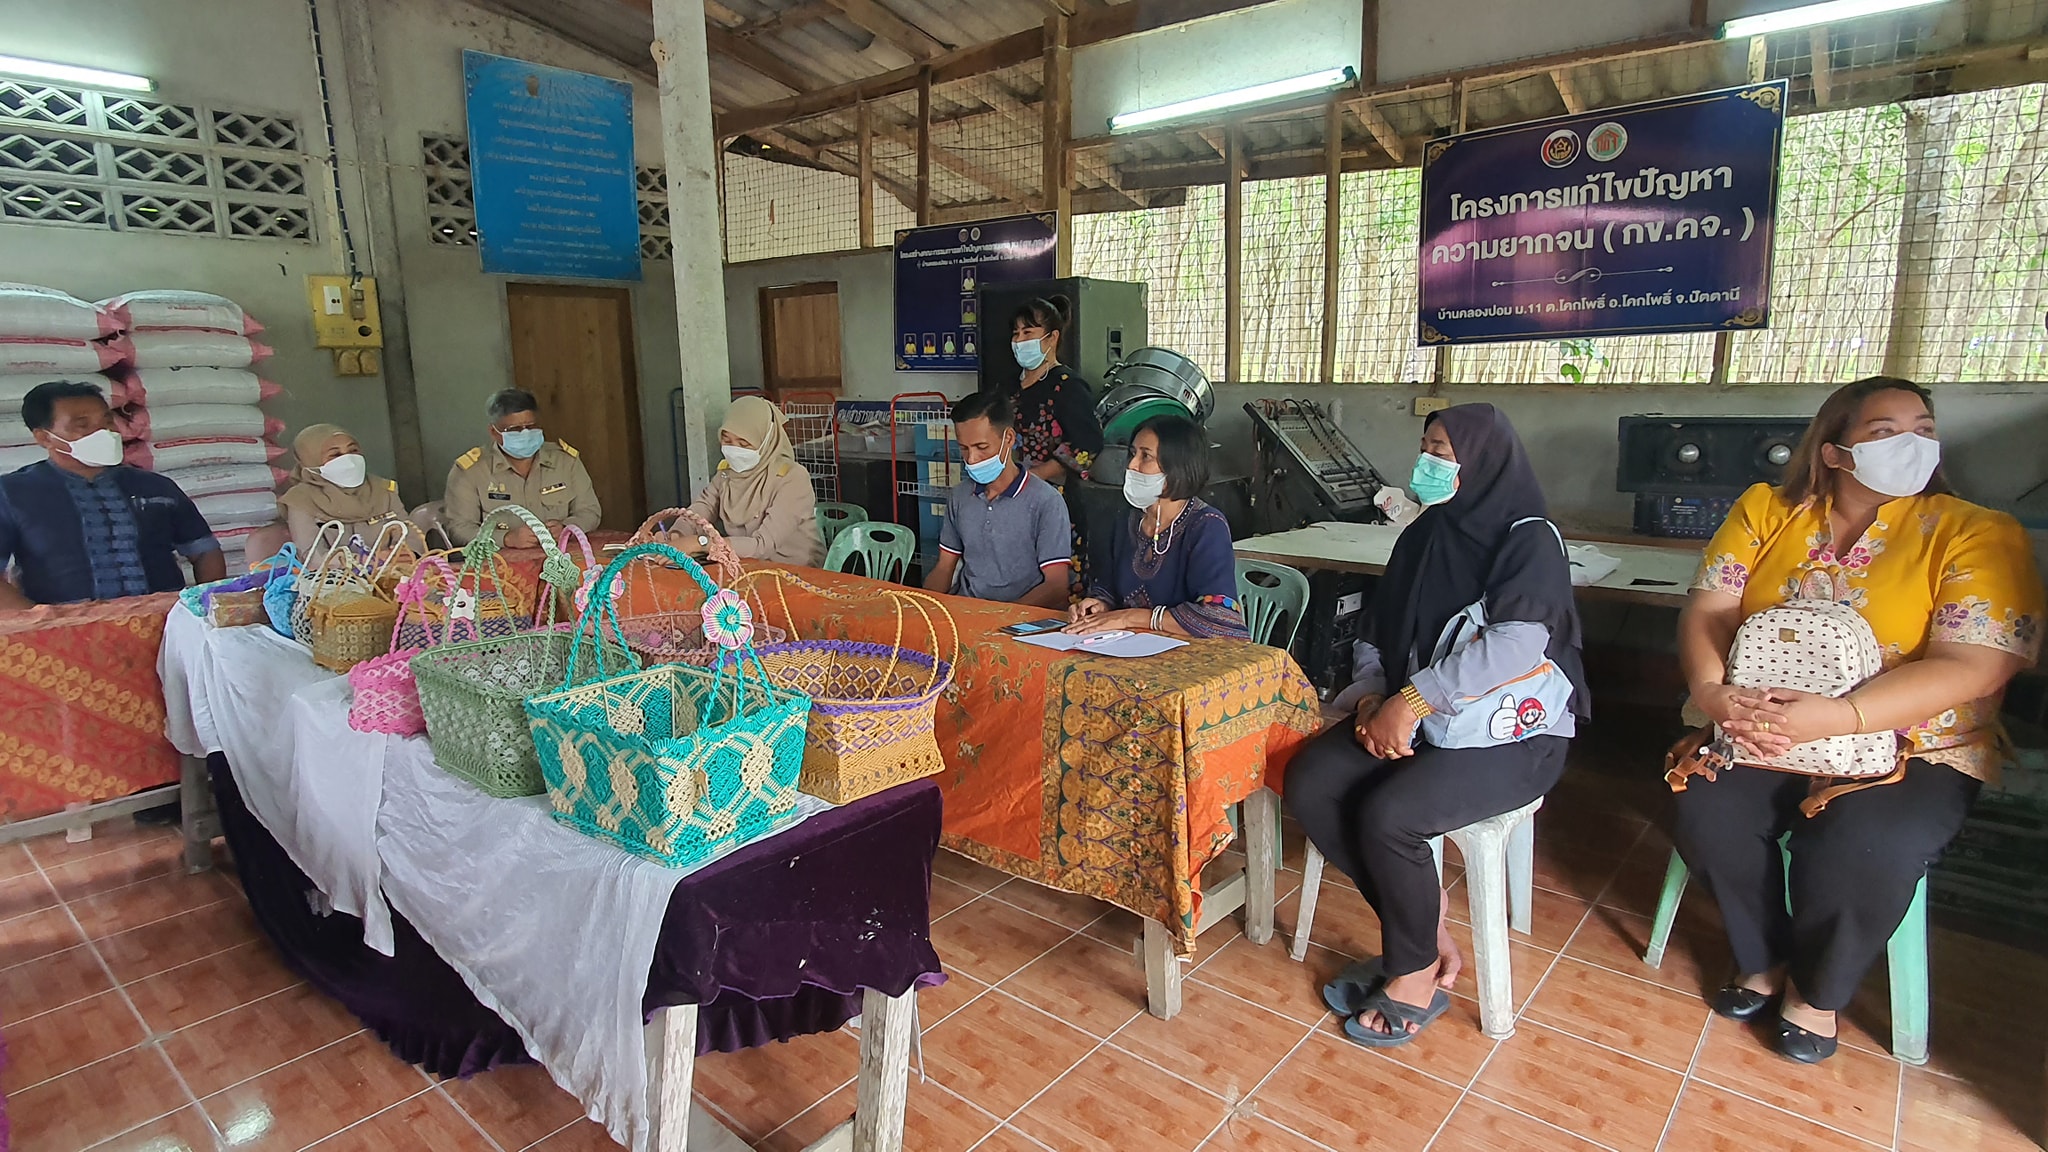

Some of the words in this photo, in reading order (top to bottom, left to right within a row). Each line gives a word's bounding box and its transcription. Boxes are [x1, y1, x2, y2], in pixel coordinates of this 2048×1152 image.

[1450, 166, 1733, 222] โครงการแก้ไขปัญหา
[1432, 228, 1595, 265] ความยากจน
[1438, 303, 1512, 321] บ้านคลองปอม
[1515, 302, 1542, 315] ม.11
[1545, 293, 1606, 313] ต.โคกโพธิ์
[1609, 288, 1673, 308] อ.โคกโพธิ์
[1676, 286, 1741, 305] จ.ปัตตานี
